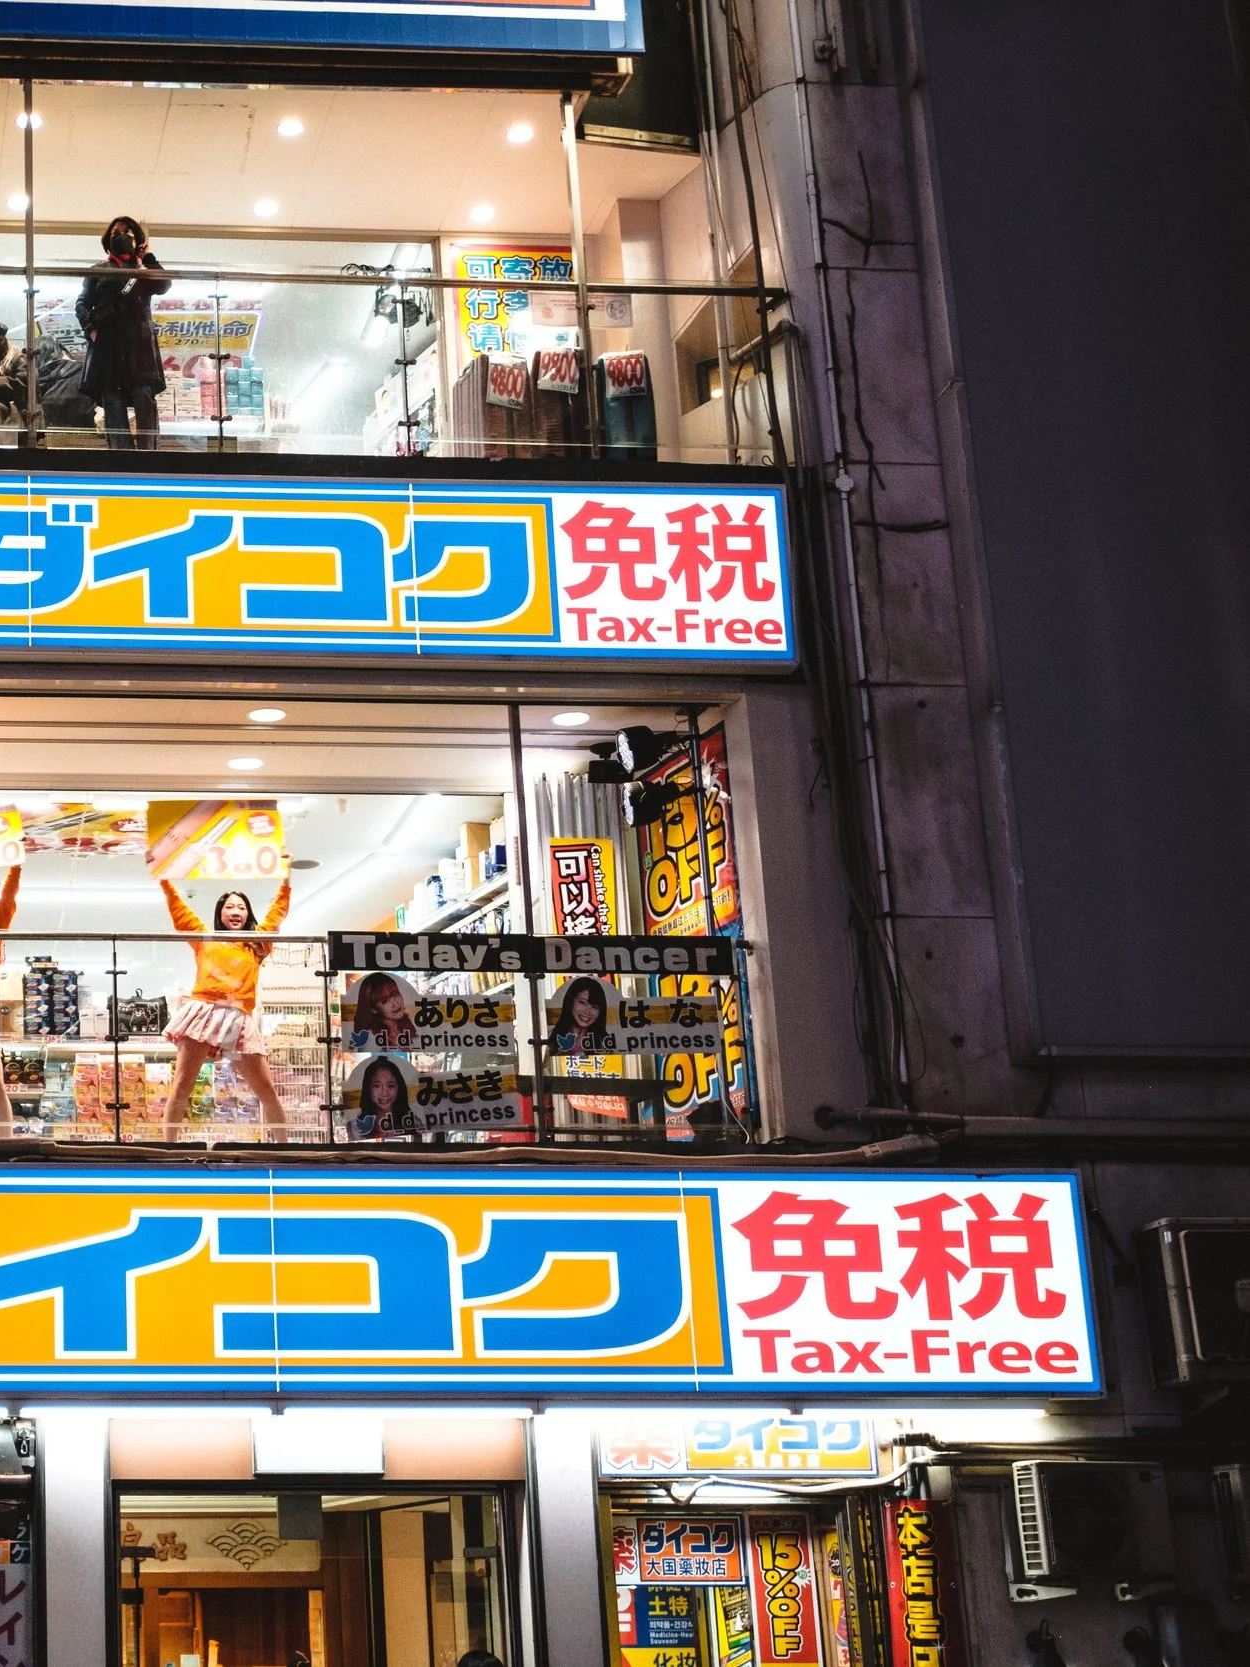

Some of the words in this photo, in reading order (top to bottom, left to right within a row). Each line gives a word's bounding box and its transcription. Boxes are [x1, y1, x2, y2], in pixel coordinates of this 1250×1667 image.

[607, 356, 645, 388] 9800
[560, 500, 777, 603] 免税
[566, 607, 783, 646] Tax-Free
[342, 935, 522, 970] Today's
[545, 937, 718, 973] Dancer
[413, 997, 500, 1029] ありさ
[375, 1029, 509, 1050] d_d_princess
[581, 1032, 716, 1053] d_d_princess
[416, 1069, 504, 1107] みさき
[379, 1105, 516, 1135] d_d_princess
[730, 1190, 1067, 1321] 免税
[742, 1329, 1079, 1374] Tax-Free
[641, 1522, 736, 1555] ダイコク
